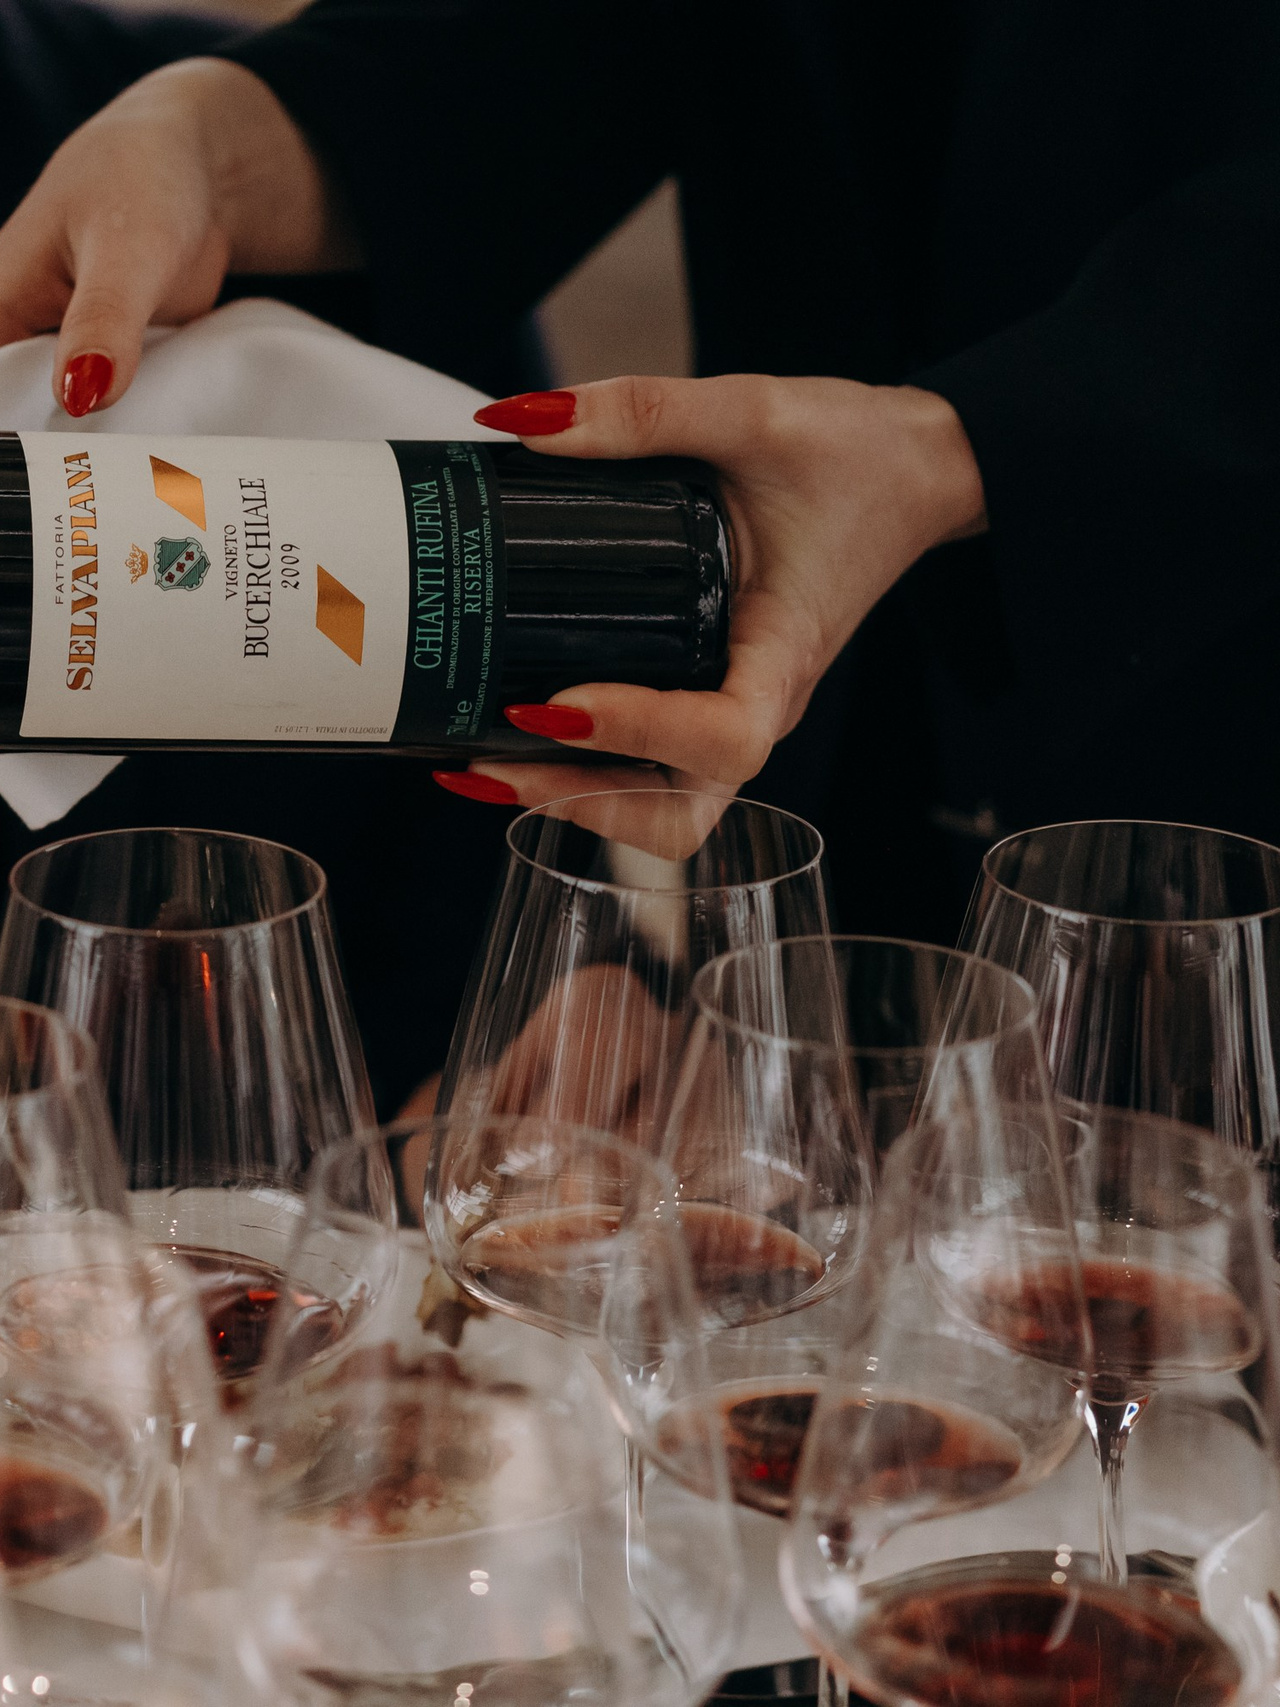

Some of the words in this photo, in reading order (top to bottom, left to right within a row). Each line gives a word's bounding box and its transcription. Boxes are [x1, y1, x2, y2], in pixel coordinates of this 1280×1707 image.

[476, 475, 488, 506] MASSETI
[410, 479, 445, 560] RUFINA
[449, 509, 461, 566] CONTROLLATA
[482, 517, 493, 559] GIUNTINI
[54, 514, 65, 605] FATTORIA
[63, 451, 98, 691] SELVAPIANA
[223, 524, 238, 601] VIGNETO
[238, 477, 272, 659] BUCERCHIALE
[280, 543, 301, 590] 2009
[452, 567, 461, 605] ORIGINE
[463, 527, 482, 614] RISERVA
[484, 560, 494, 607] FEDERICO
[412, 567, 446, 670] CHIANTI
[452, 606, 461, 618] DI
[484, 609, 494, 623] DA
[445, 619, 461, 690] DENOMINAZIONE
[480, 625, 493, 681] ALL'ORIGINE
[348, 726, 388, 734] PRODOTTO
[456, 700, 472, 714] e
